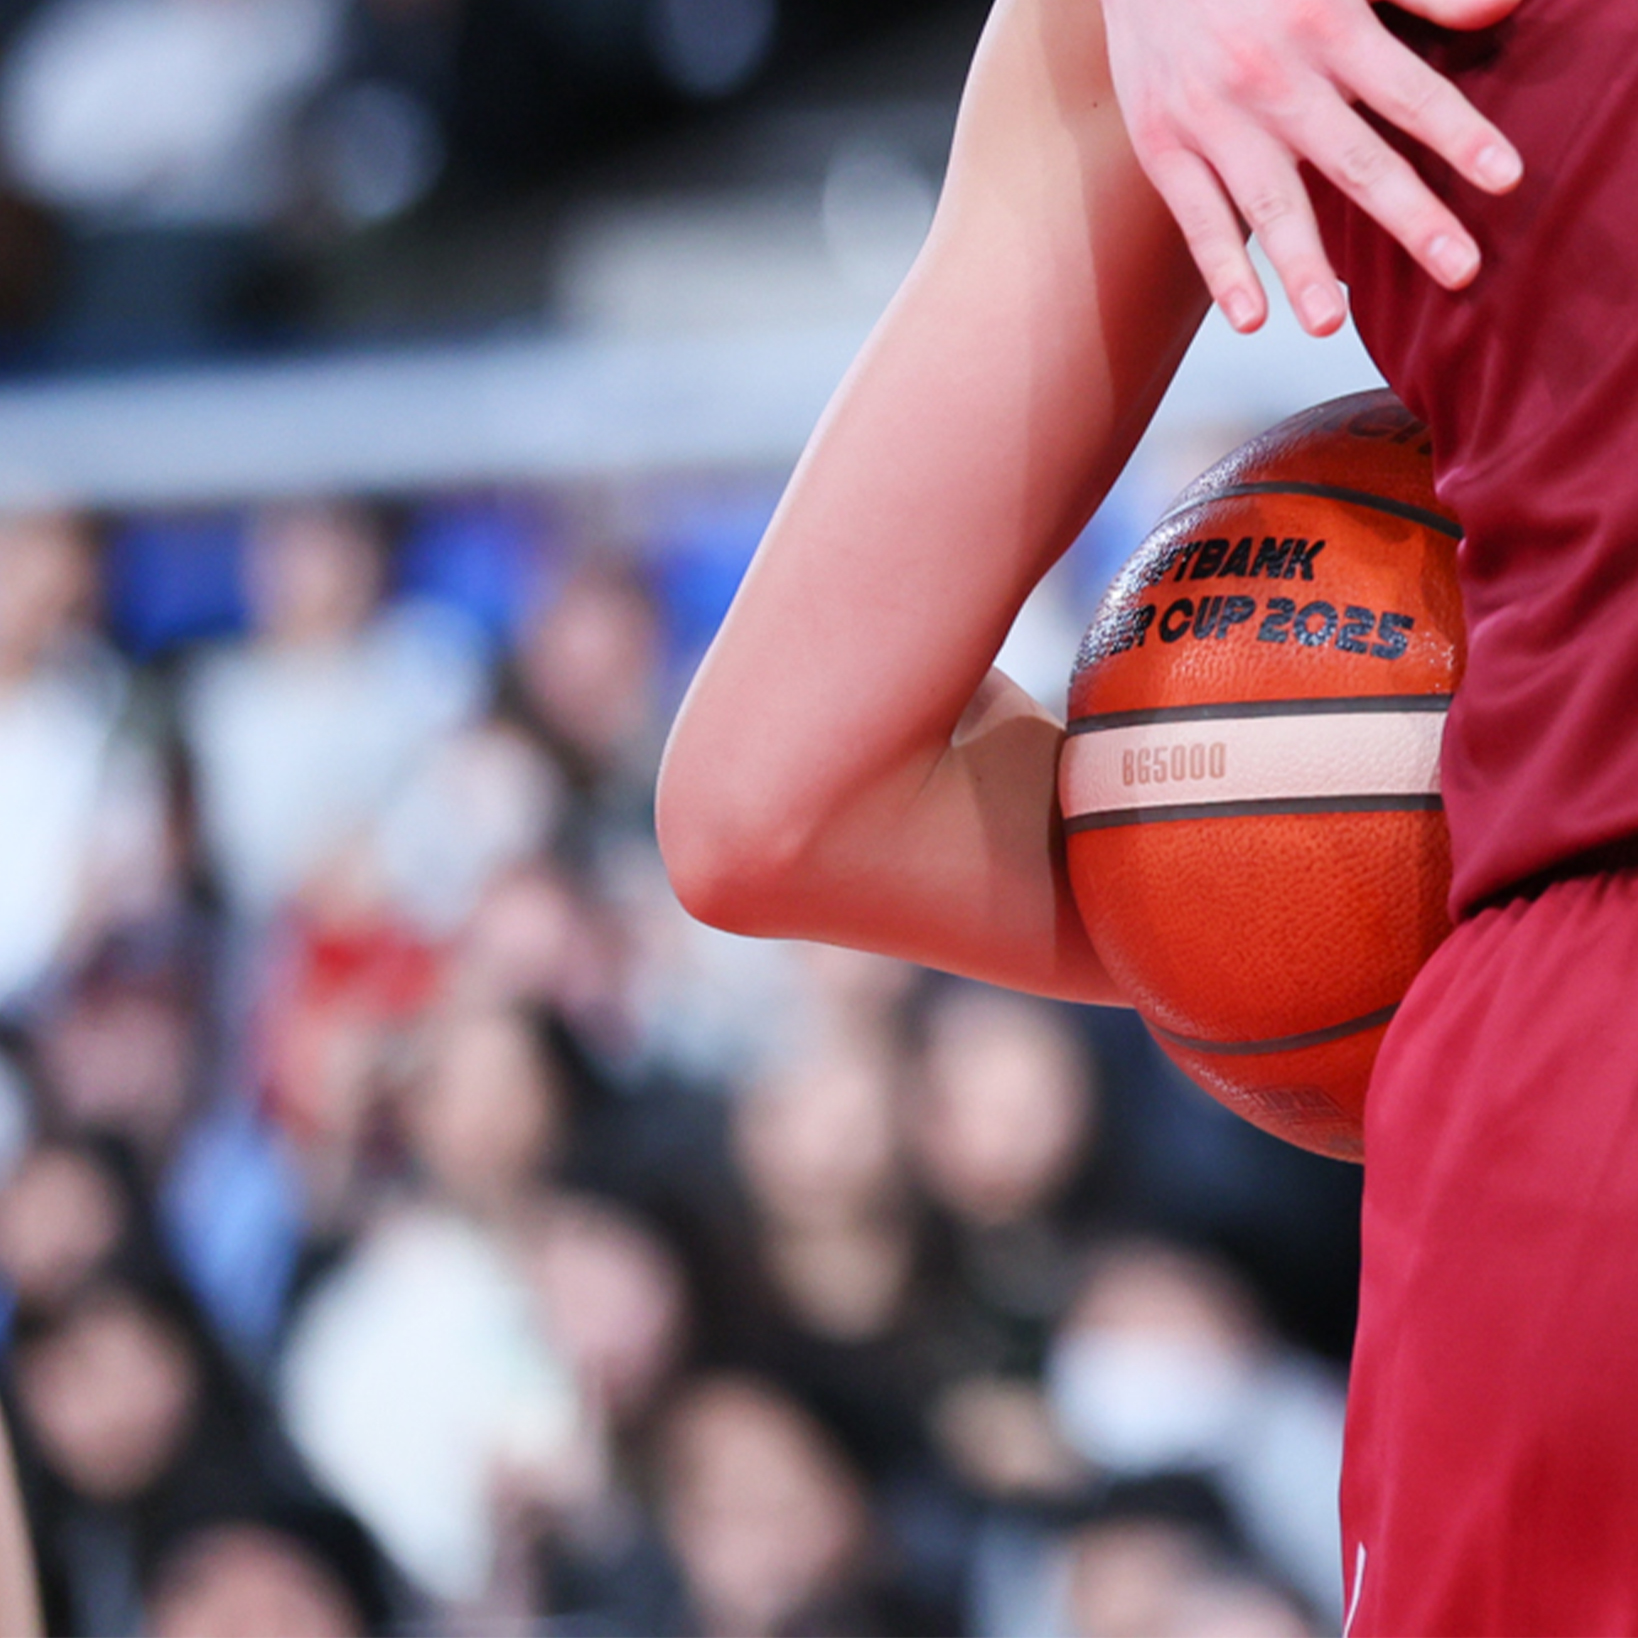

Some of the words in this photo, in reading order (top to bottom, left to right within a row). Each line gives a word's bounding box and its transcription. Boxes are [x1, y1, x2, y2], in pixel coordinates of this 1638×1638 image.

[1132, 537, 1325, 585] TBANK
[1158, 595, 1257, 643] CUP
[1257, 597, 1415, 660] 2025
[1122, 741, 1227, 787] BG5000
